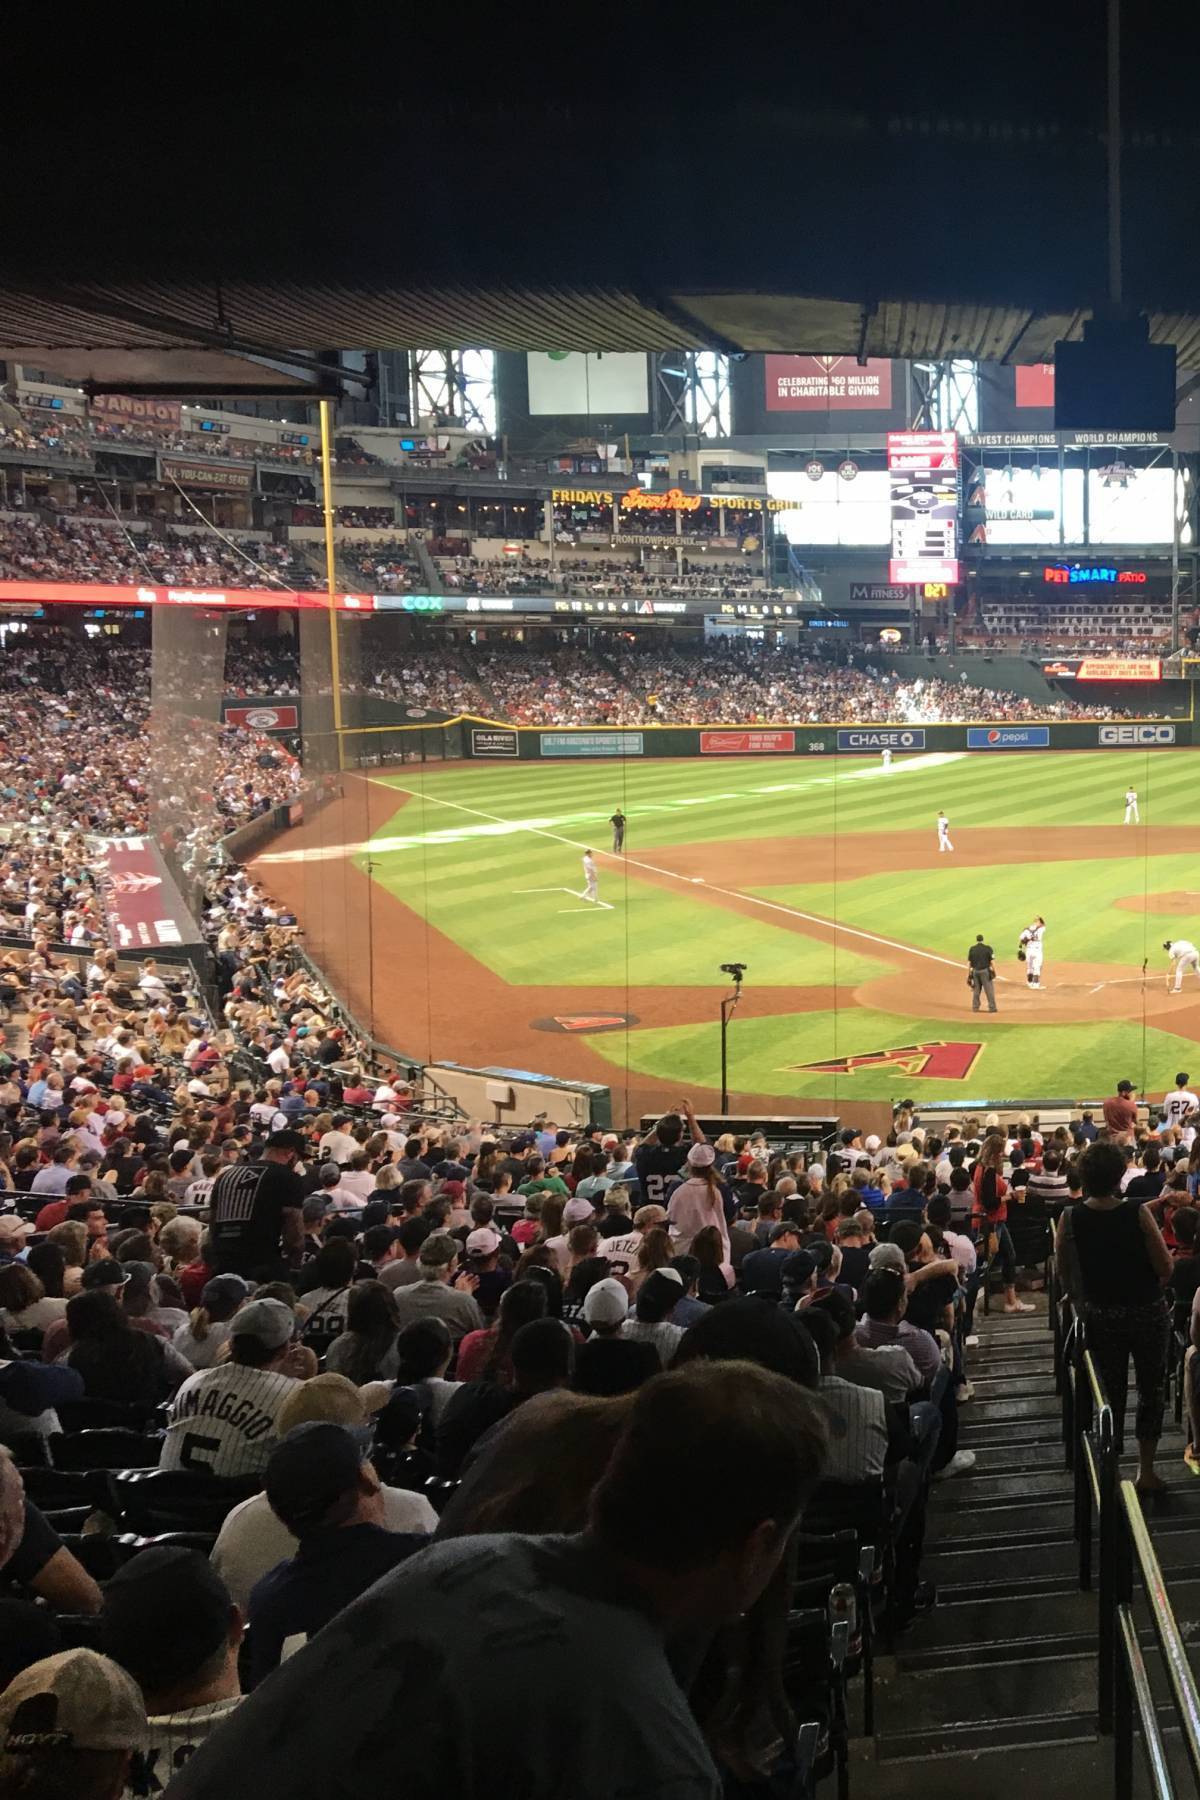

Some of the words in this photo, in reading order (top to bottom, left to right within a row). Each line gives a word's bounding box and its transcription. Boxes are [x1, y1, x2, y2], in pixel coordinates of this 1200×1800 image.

[777, 376, 829, 387] CELEBRATING
[831, 375, 846, 386] $60
[847, 375, 880, 385] MILLION
[777, 386, 788, 397] IN
[790, 385, 846, 397] CHARITABLE
[848, 384, 880, 396] GIVING
[964, 435, 975, 444] NL
[977, 435, 1002, 445] WEST
[1004, 434, 1056, 444] CHAMPIONS
[1075, 433, 1104, 444] WORLD
[1106, 432, 1158, 442] CHAMPIONS
[710, 496, 763, 510] SPORTS
[766, 499, 803, 511] GRILL
[985, 510, 1007, 520] WILD
[1009, 510, 1033, 520] CARD
[1118, 572, 1147, 583] PATIO
[852, 586, 868, 599] M
[870, 588, 905, 600] FITNESS
[402, 596, 442, 610] COX
[849, 734, 898, 746] CHASE
[1002, 732, 1028, 743] pepsi
[1100, 726, 1175, 744] GEICO
[808, 742, 825, 751] 368
[1171, 1100, 1190, 1114] 27
